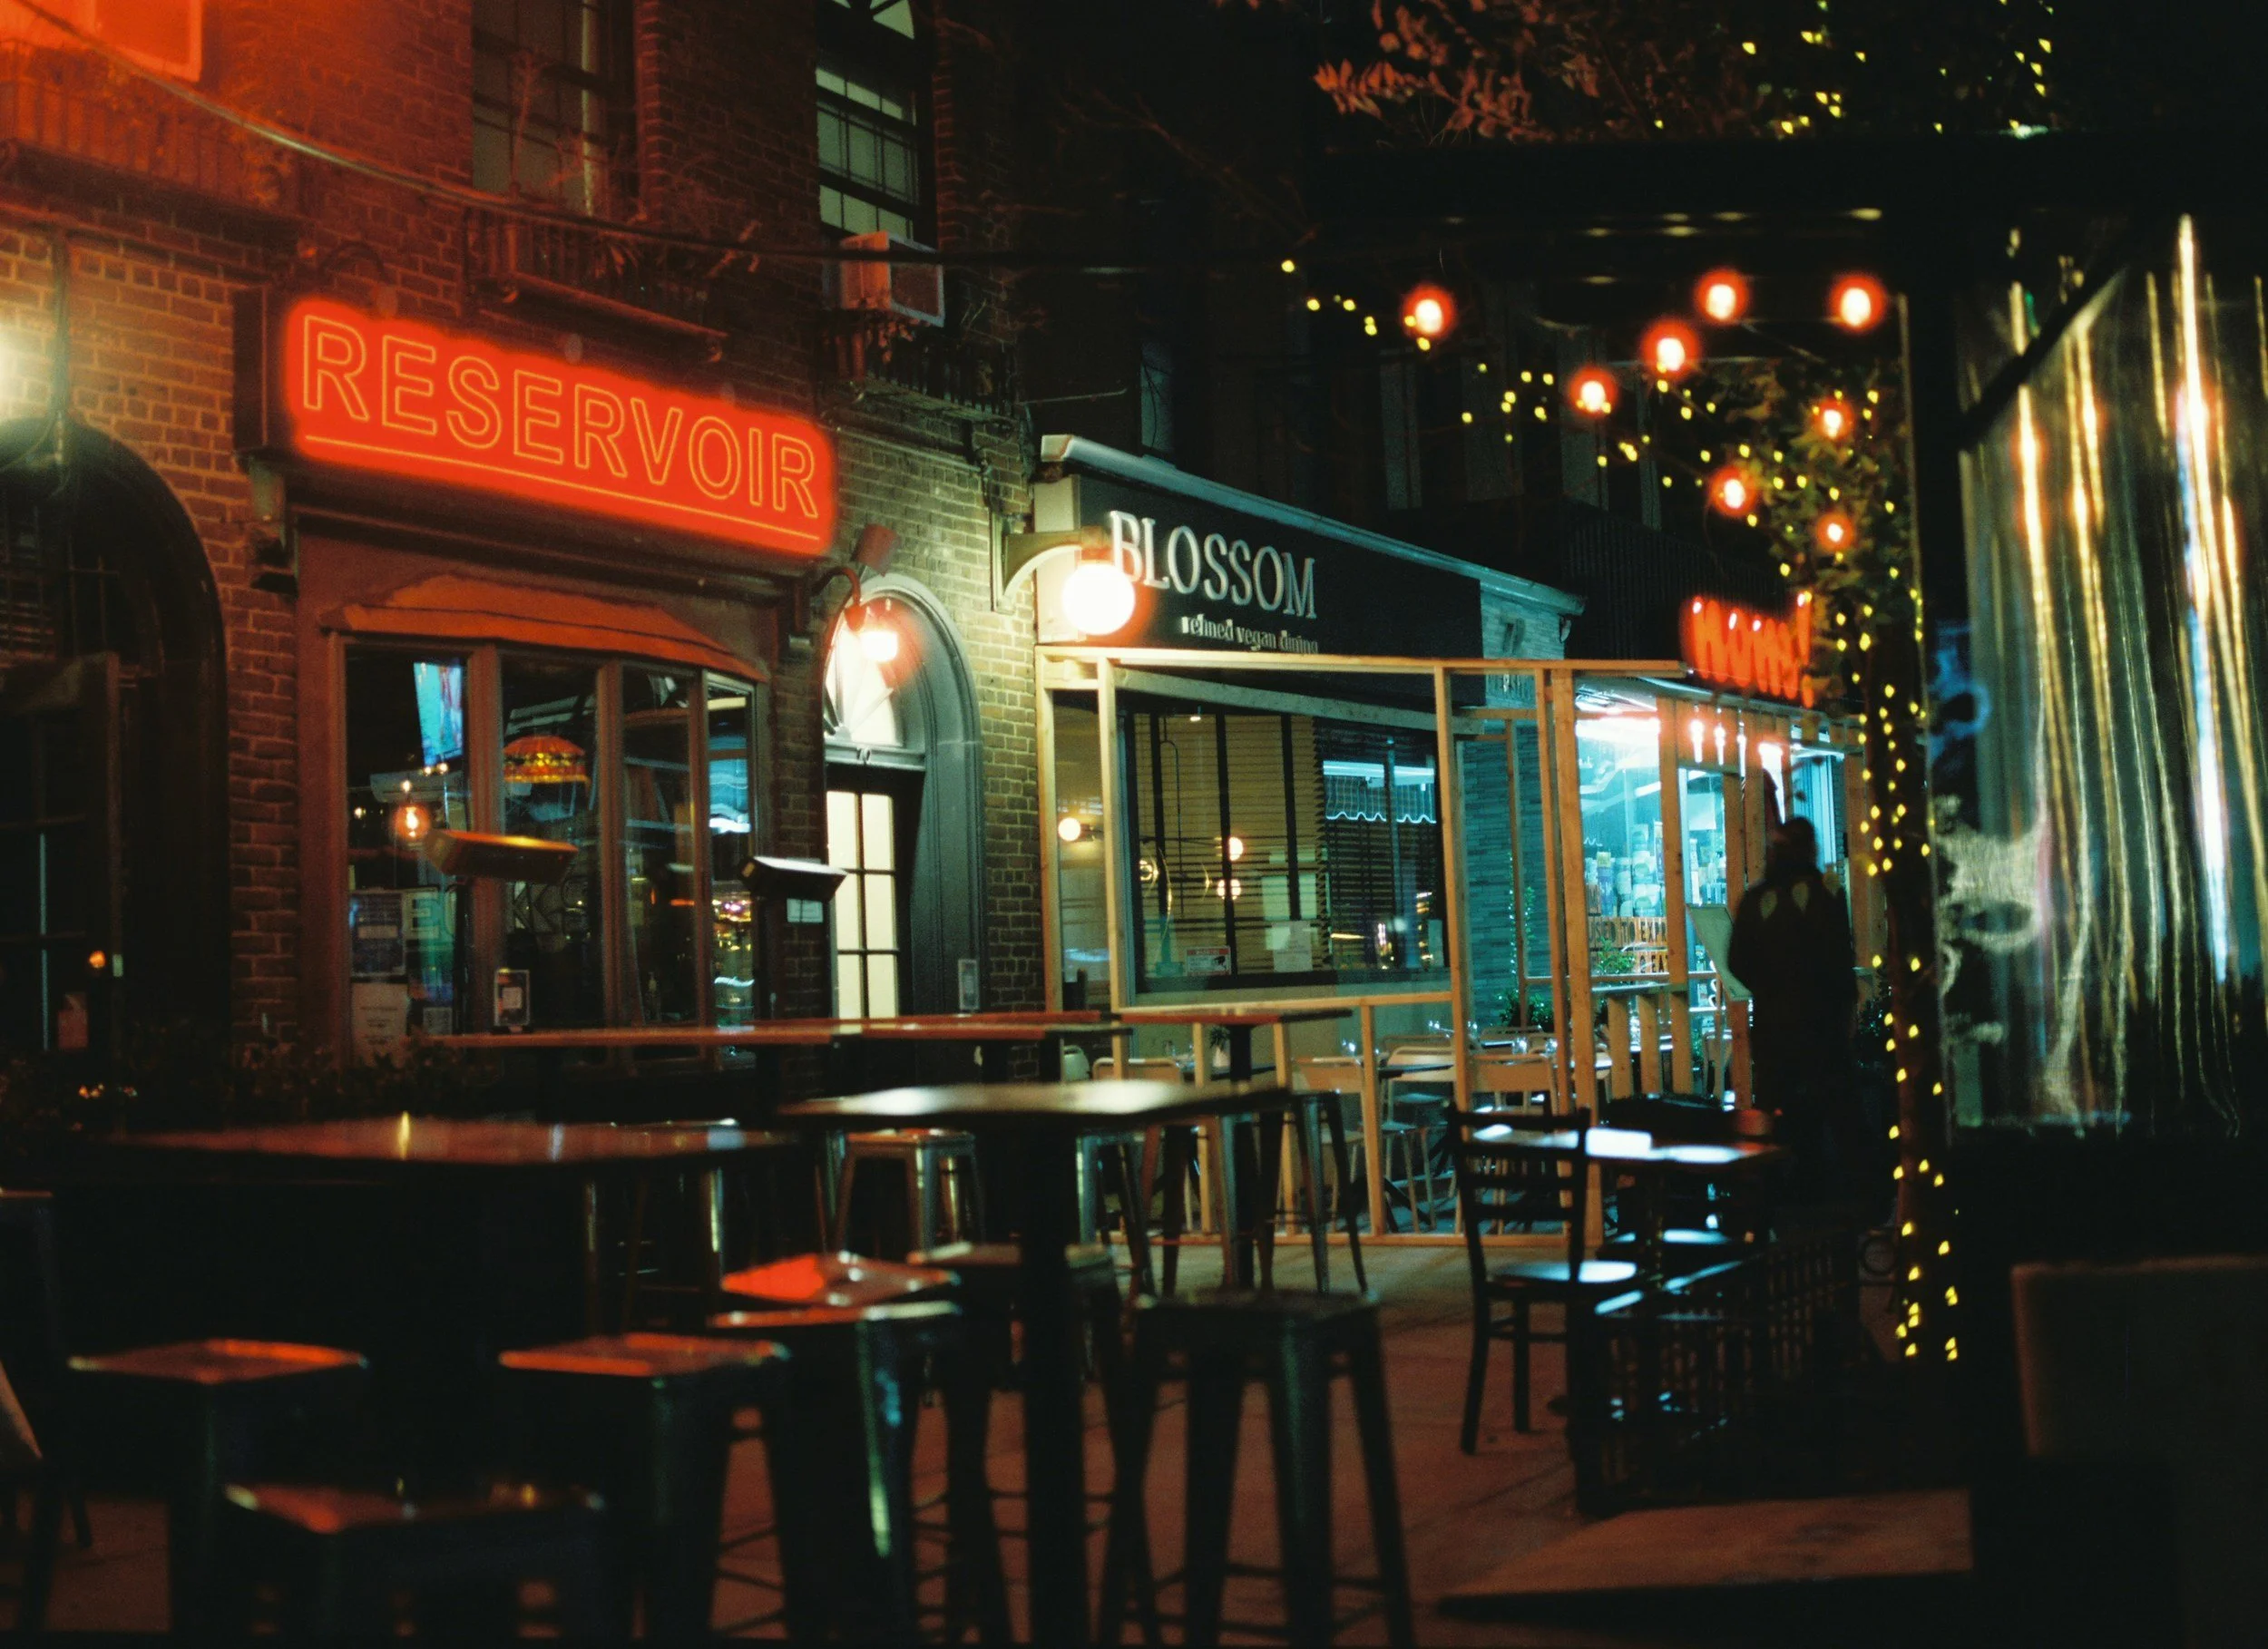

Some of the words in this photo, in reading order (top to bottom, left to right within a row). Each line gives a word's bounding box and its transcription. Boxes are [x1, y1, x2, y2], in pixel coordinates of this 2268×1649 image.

[304, 314, 818, 518] RESERVOIR
[1110, 510, 1316, 619] BLOSSOM
[1180, 613, 1234, 642] refined
[1236, 626, 1277, 651] vegan
